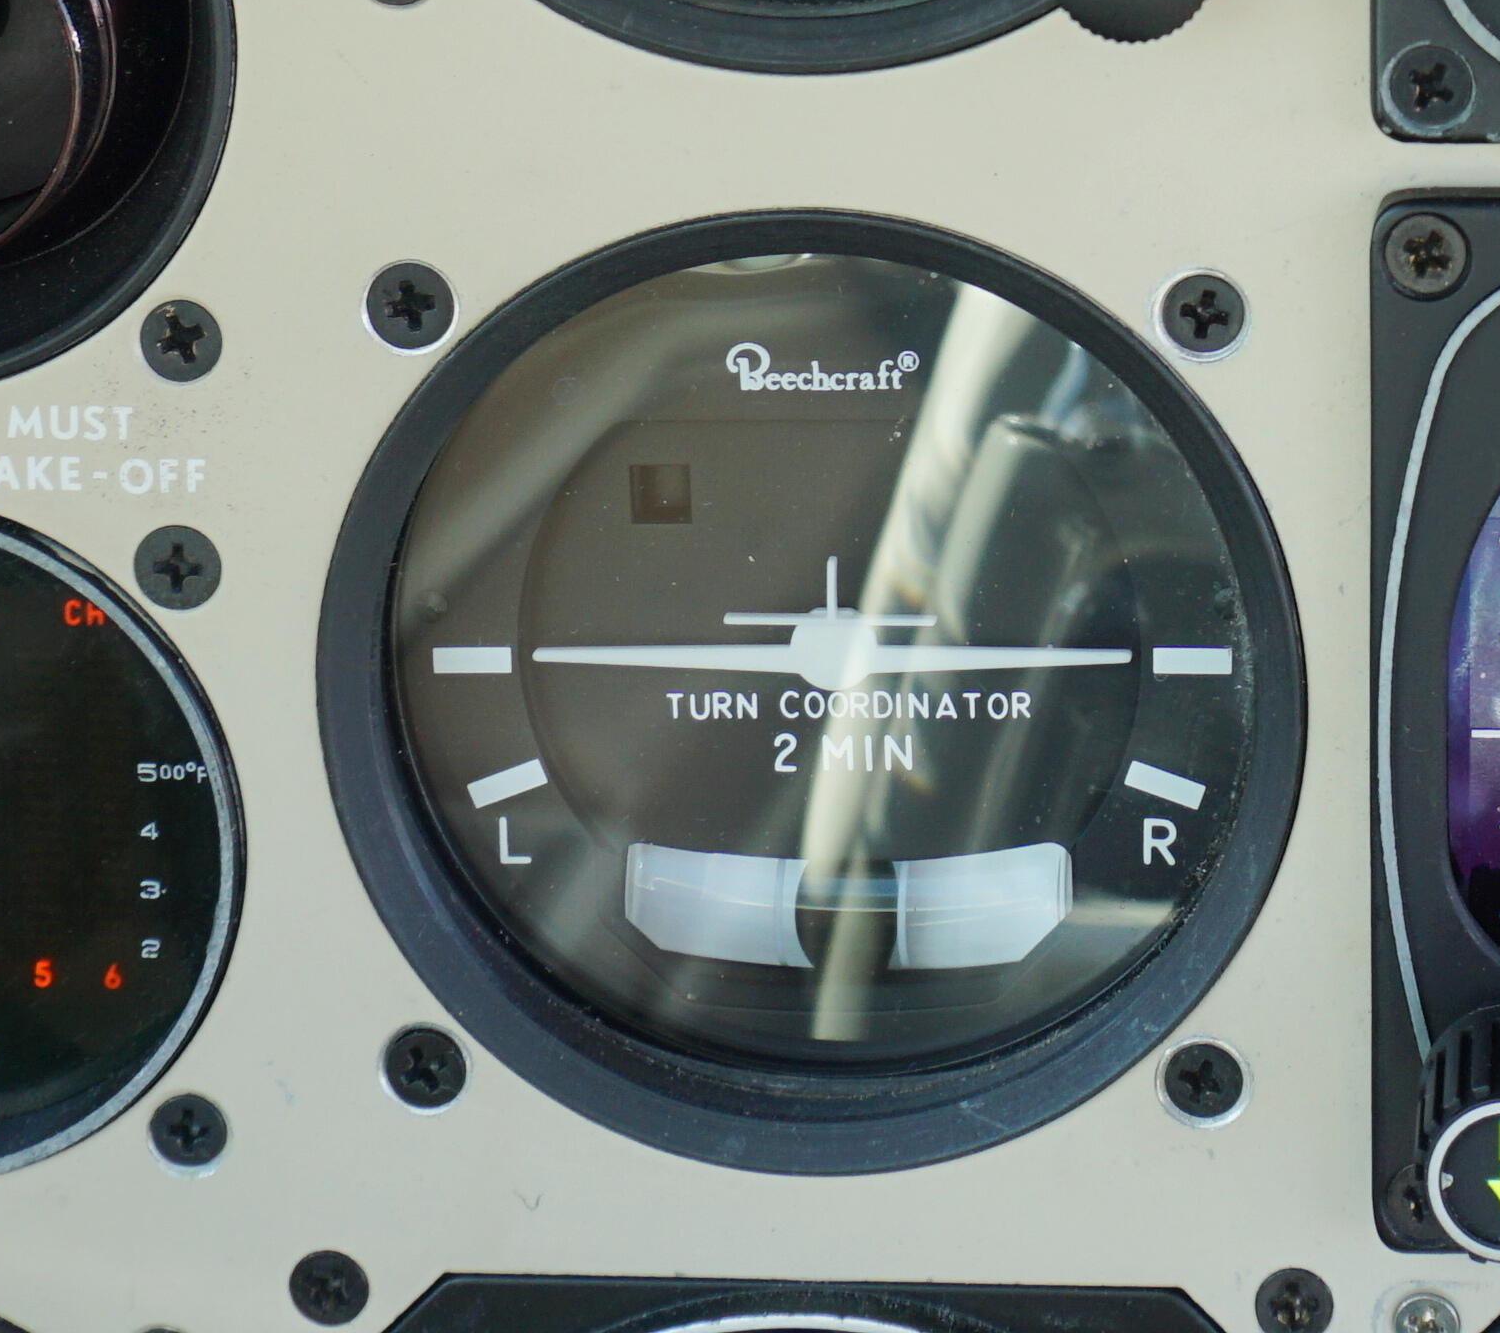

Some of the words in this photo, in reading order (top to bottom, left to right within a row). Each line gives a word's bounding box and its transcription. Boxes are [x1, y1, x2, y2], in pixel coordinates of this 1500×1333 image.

[5, 405, 136, 442] MUST
[665, 690, 760, 721] TURN
[779, 690, 1033, 721] COORDINATOR
[772, 734, 799, 774] 2
[821, 733, 916, 774] MIN
[139, 820, 161, 842] 4
[498, 817, 533, 866] L
[1144, 817, 1178, 867] R
[139, 878, 162, 901] 3
[139, 937, 162, 960] 2
[33, 959, 53, 990] 5
[103, 961, 124, 993] 6
